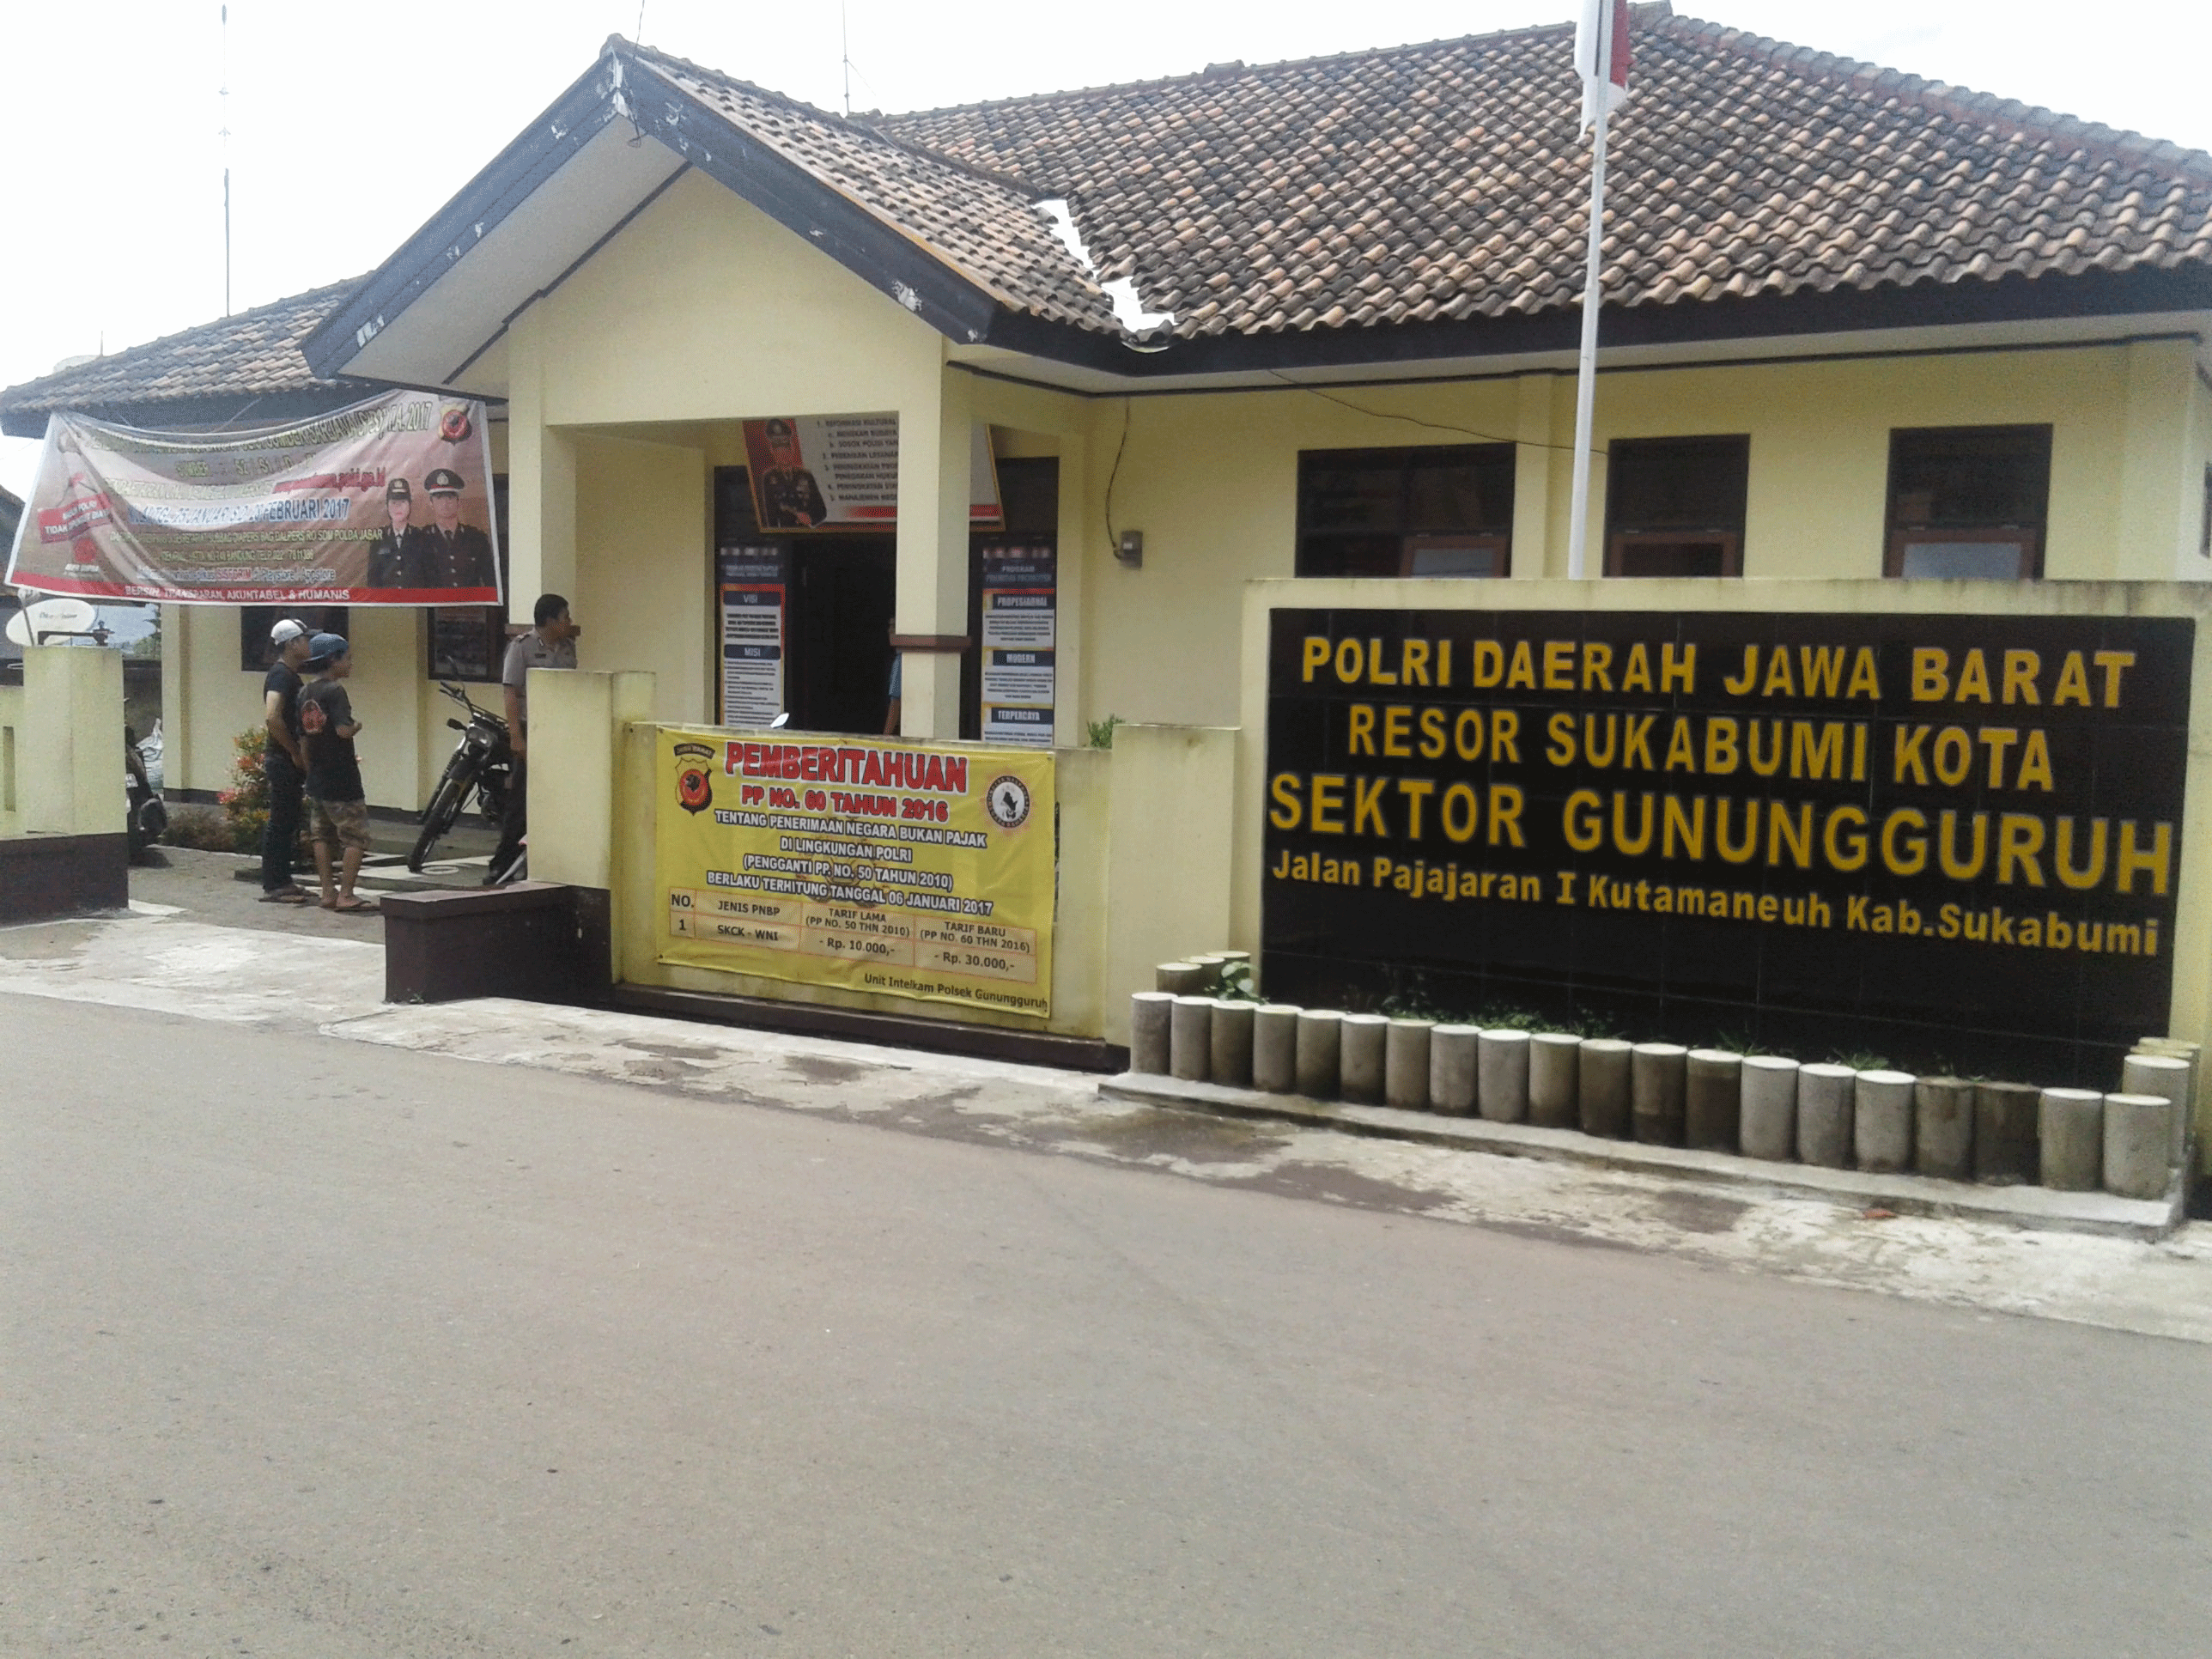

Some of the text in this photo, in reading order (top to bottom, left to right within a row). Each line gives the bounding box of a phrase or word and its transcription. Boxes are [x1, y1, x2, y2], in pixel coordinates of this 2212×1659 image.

[408, 401, 432, 431] 2017
[323, 497, 350, 520] 2017
[45, 525, 69, 535] TIDAK
[335, 529, 358, 541] POLDA
[227, 589, 286, 600] AKUNTABEL
[299, 589, 350, 601] HUMANIS
[743, 593, 758, 604] VISI
[744, 647, 761, 657] MISI
[1006, 653, 1036, 664] MODERN
[1303, 636, 2136, 708] POLRI DAERAH JAWA BARAT
[1349, 704, 2053, 792] RESOR SUKABUMI KOTA
[726, 741, 968, 793] PEMBERITAHUAN
[741, 785, 949, 822] PP NO. 60 TAHUN 2016
[714, 810, 988, 848] TENTANG PENERIMAAN NEGARA BUKAN PAJAK
[1270, 773, 2172, 895] SEKTOR GUNUNGGURUH
[781, 837, 912, 862] DI LINGKUNGAN POLRI
[744, 854, 953, 892] (PENGGANTI PP. NO. 50 TAHUN 2010)
[707, 870, 994, 916] BERLAKU TERHITUNG TANGGAL 06 JANUARI 2017
[1273, 851, 2158, 957] Jalan Pajajaran I Kutamaneuh Kab.Sukabumi
[671, 894, 1006, 937] NO. JENIS PNBP TARIF LAMA TARIF BARU
[678, 919, 686, 931] 1
[717, 924, 744, 937] SKCK
[755, 928, 779, 941] WNI
[827, 937, 846, 951] Rp.
[943, 951, 961, 965] Rp.
[965, 953, 1015, 972] 30.000,-
[805, 915, 823, 927] (PP
[825, 919, 841, 928] NO.
[845, 921, 857, 929] 50
[860, 922, 879, 933] THN
[882, 925, 910, 937] 2010)
[921, 930, 937, 941] (PP
[960, 934, 973, 945] 60
[976, 936, 998, 948] THN
[1001, 939, 1030, 954] 2016)
[864, 972, 1048, 1009] Unit Intelkam Polsek Gunungguruh
